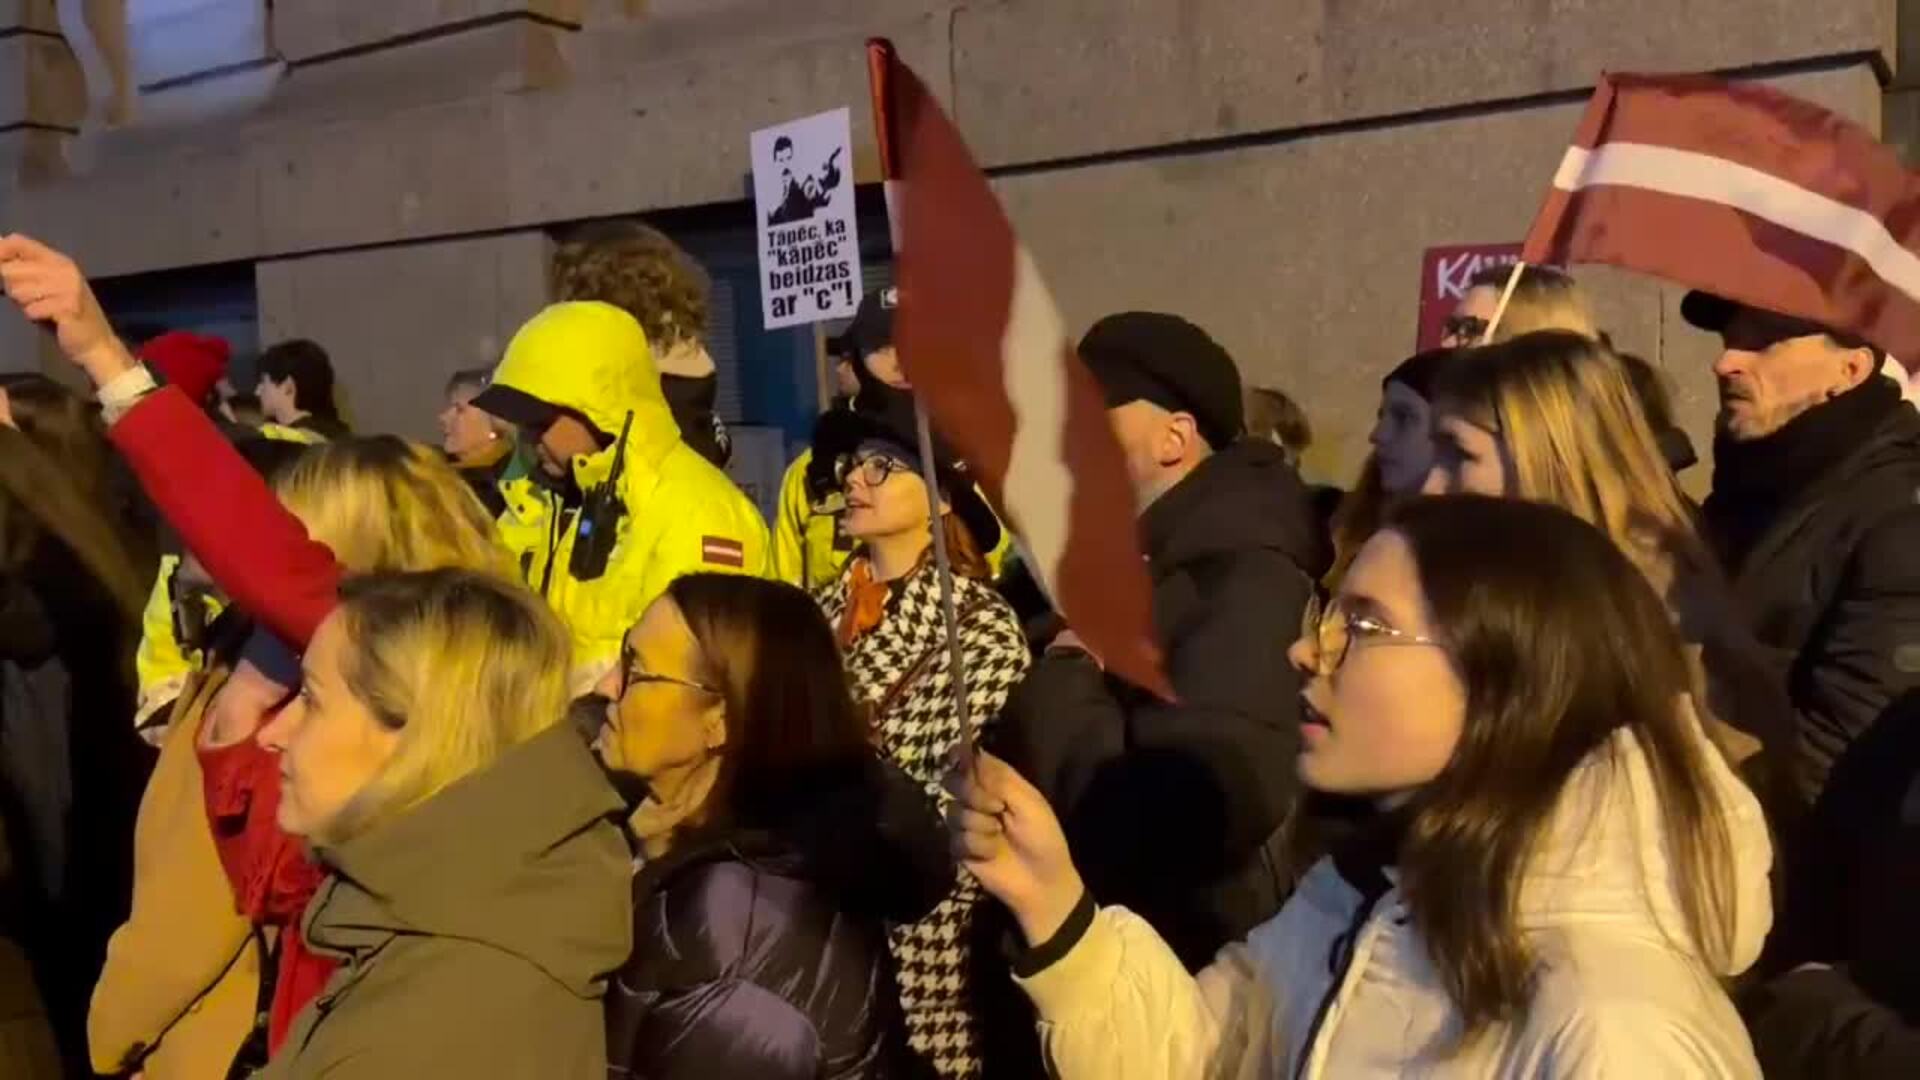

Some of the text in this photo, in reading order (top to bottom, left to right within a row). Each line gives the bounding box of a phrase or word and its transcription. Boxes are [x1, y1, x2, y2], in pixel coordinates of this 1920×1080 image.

[825, 219, 845, 237] ka
[769, 261, 850, 291] beidzas
[772, 280, 853, 318] ar "c"!
